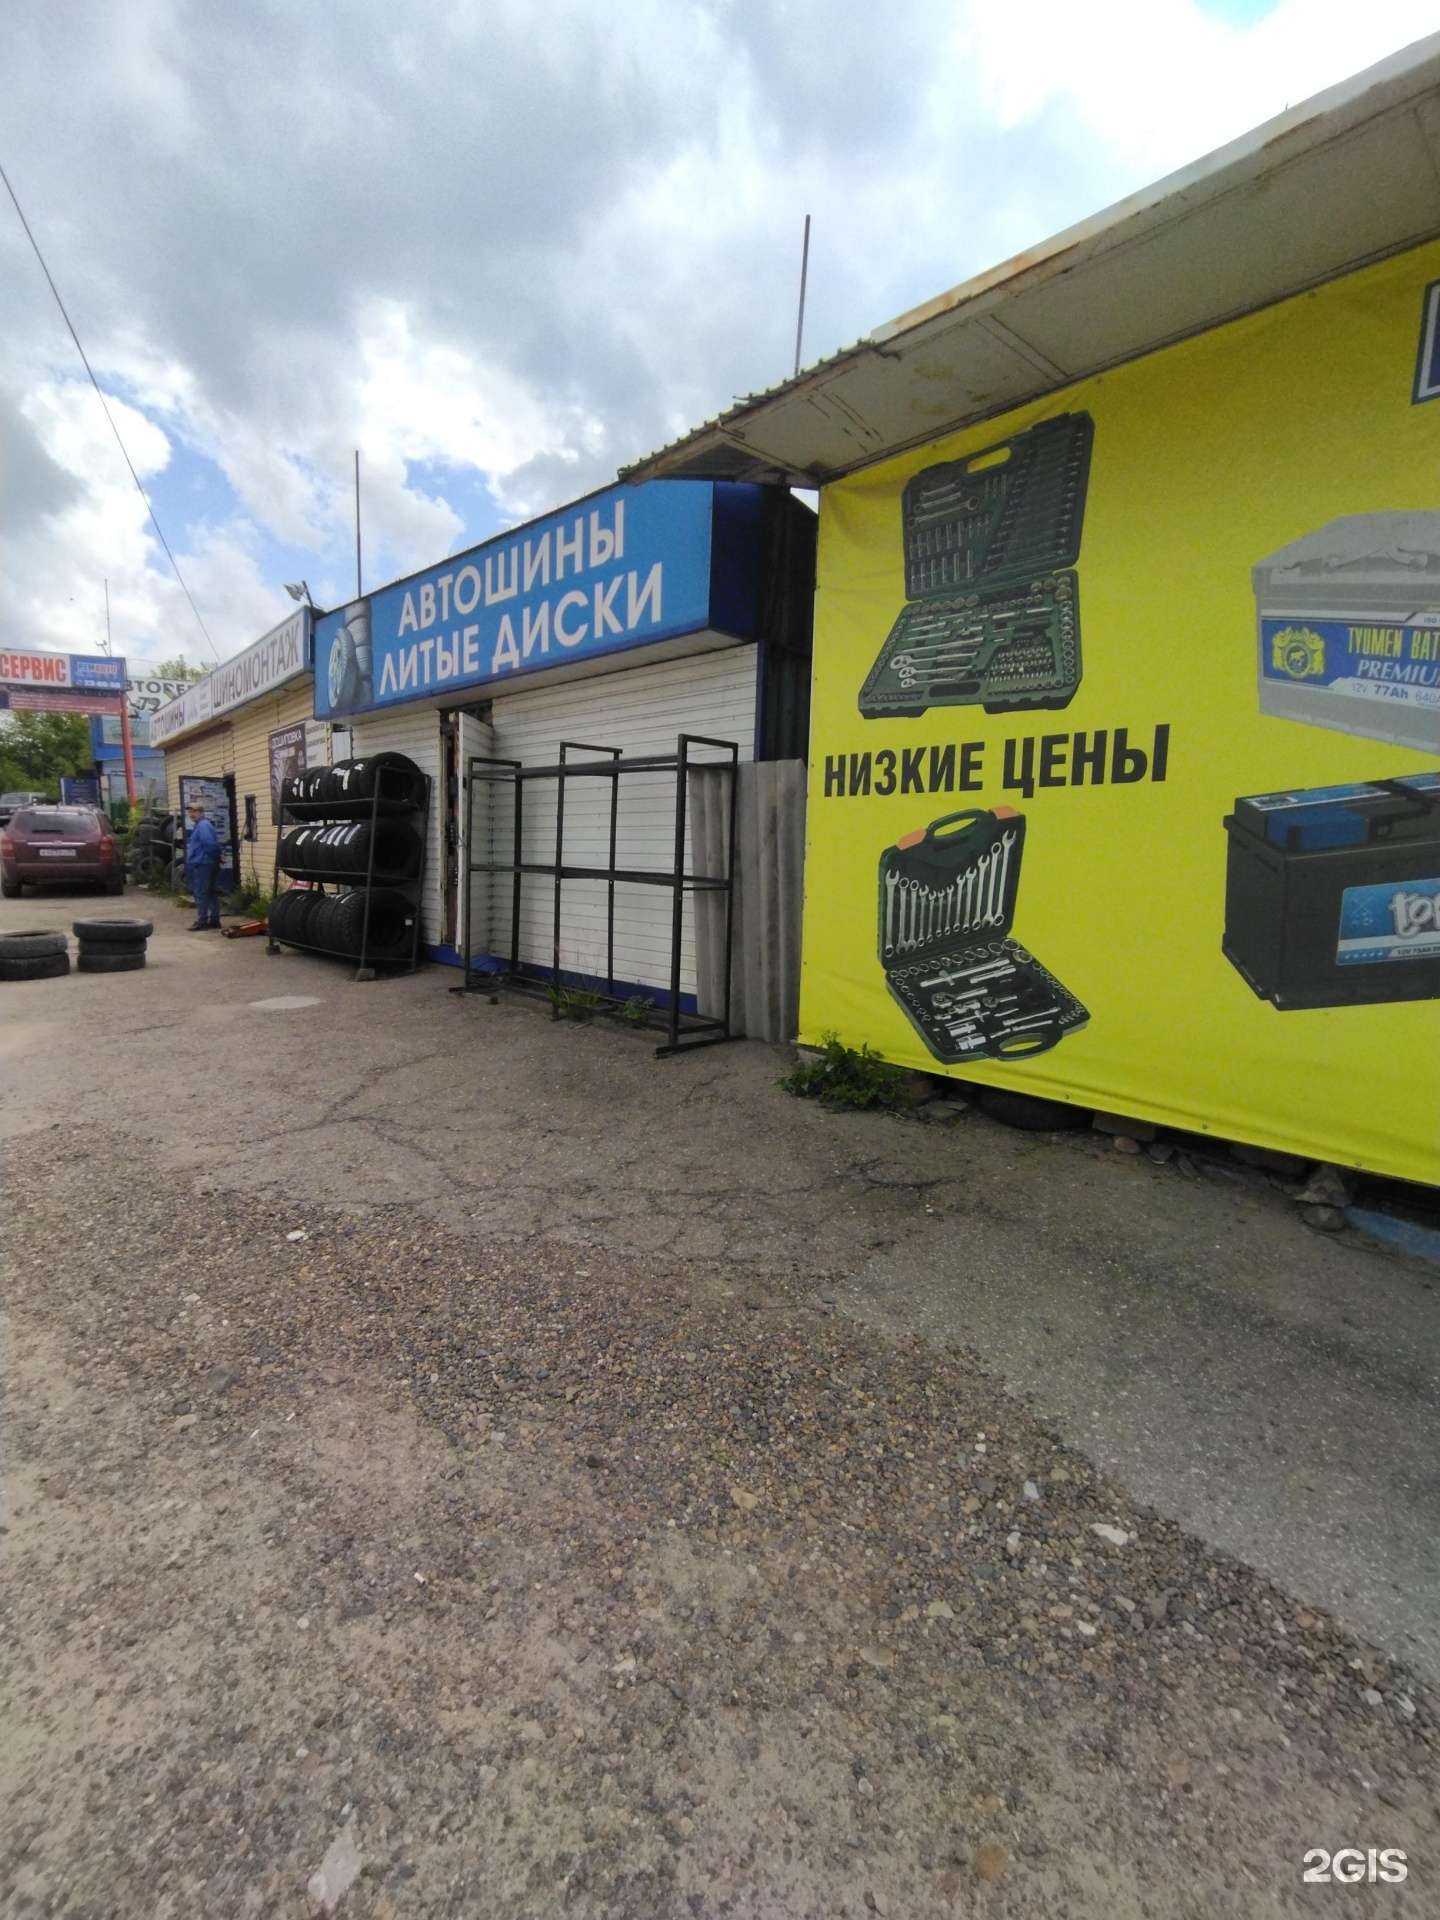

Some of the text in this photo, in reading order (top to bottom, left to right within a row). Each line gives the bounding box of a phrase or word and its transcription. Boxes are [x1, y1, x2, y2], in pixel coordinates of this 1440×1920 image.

[398, 500, 624, 637] АВТОШИНЫ
[379, 562, 662, 695] ЛИТЫЕ ДИСКИ
[1347, 627, 1403, 658] TYUMEN
[0, 654, 66, 682] СЕРВИС
[211, 622, 300, 708] ШИНОМОНТАЖ
[1357, 659, 1440, 687] PREMIU
[1374, 683, 1408, 699] 77Ah
[824, 724, 1170, 799] НИЗКИЕ ЦЕНЫ
